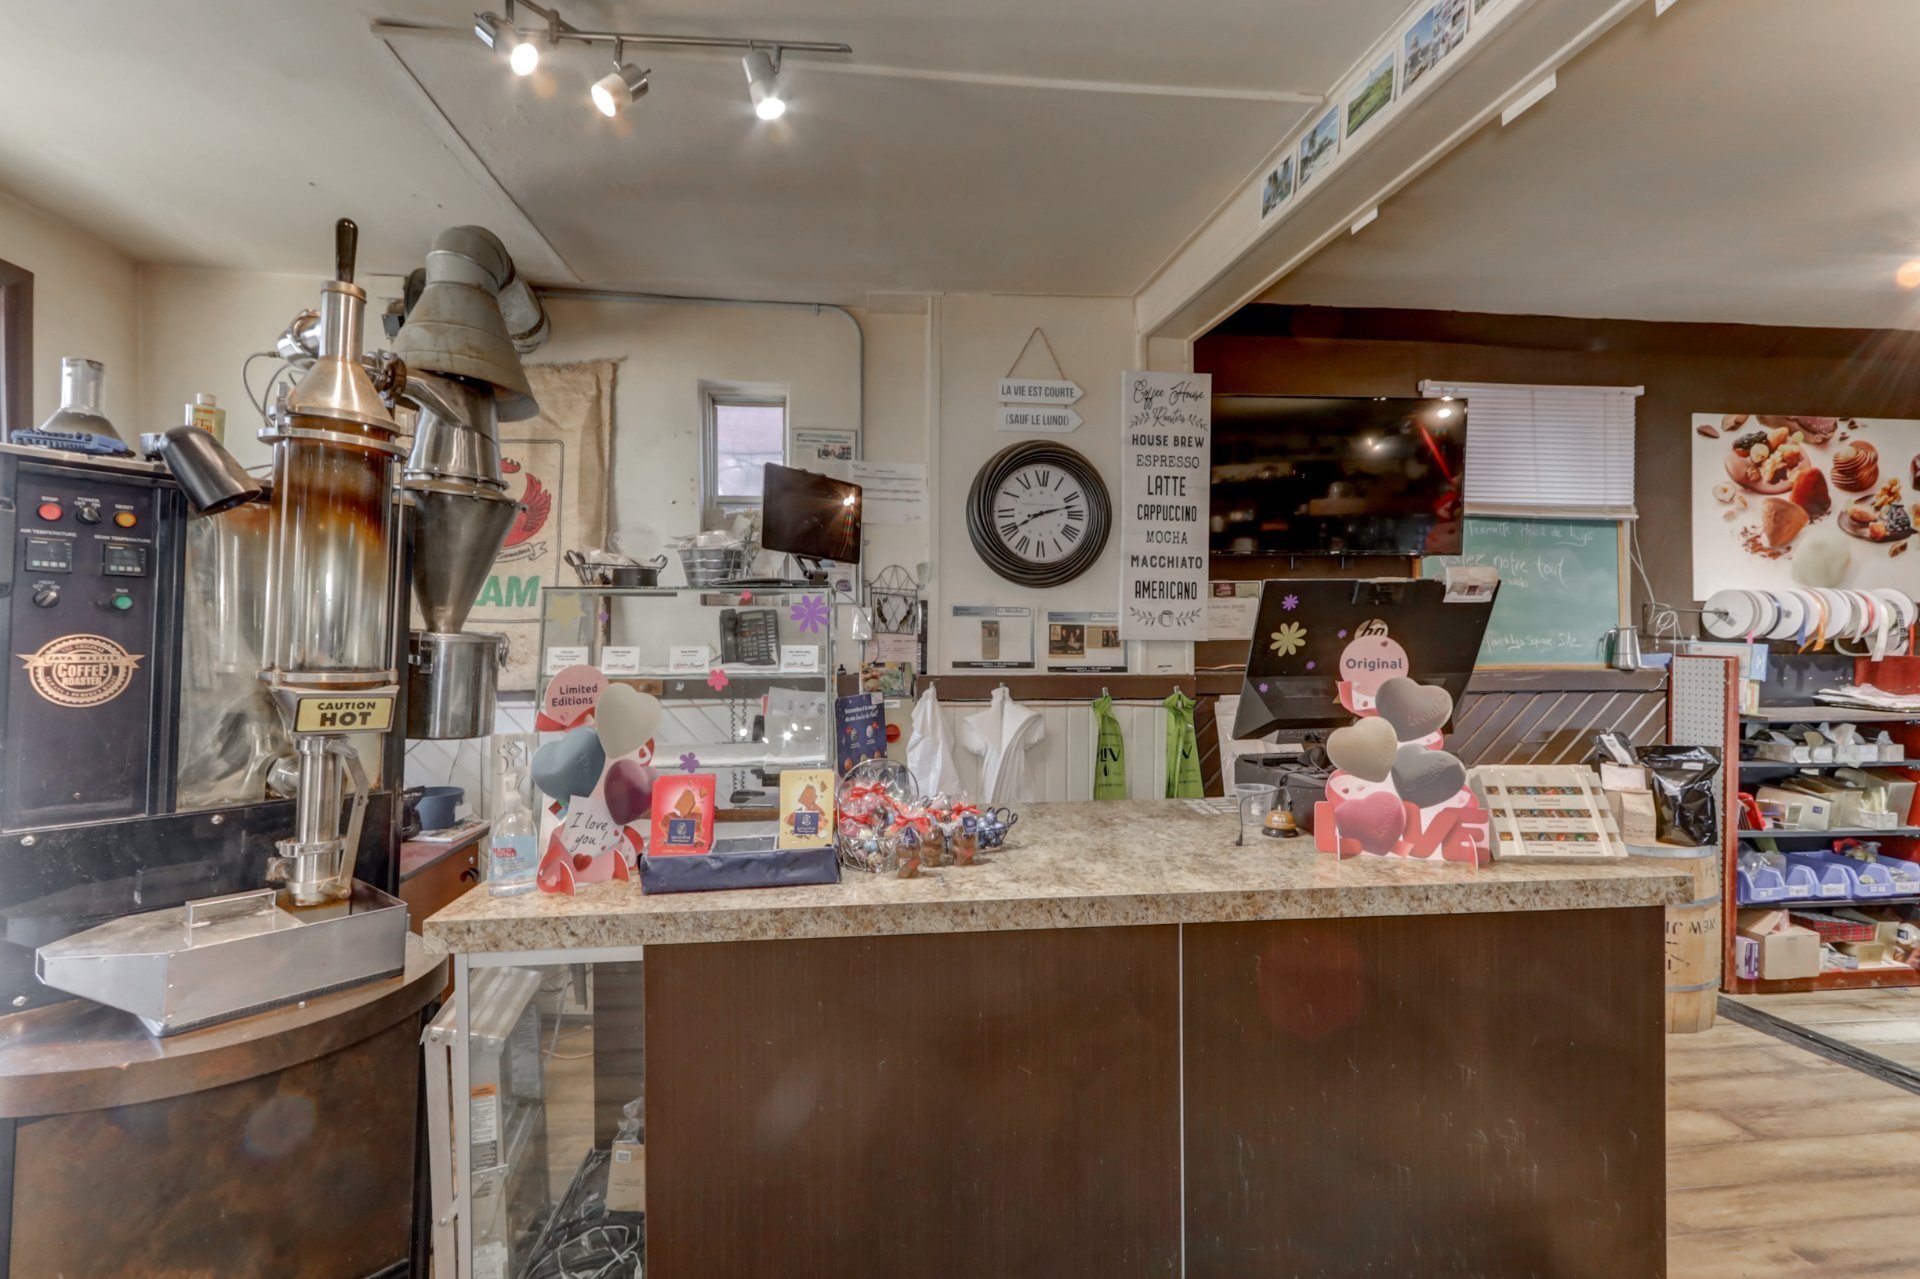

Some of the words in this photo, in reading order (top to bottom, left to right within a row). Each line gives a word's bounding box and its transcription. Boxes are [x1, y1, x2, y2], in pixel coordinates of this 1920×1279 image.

[1001, 384, 1012, 396] LA
[1013, 385, 1027, 396] VIE
[1028, 386, 1043, 397] EST
[1134, 379, 1166, 410] Coffee
[1169, 381, 1205, 405] House
[1005, 413, 1030, 426] (SAUF
[1031, 414, 1041, 425] LE
[1042, 415, 1070, 426] LUNDI)
[1132, 434, 1169, 447] HOUSE
[1173, 435, 1205, 448] BREW
[1136, 454, 1200, 469] ESPRESSO
[1147, 475, 1187, 497] LATTE
[1137, 503, 1197, 522] CAPPUCCINO
[32, 528, 78, 538] TEMPERATURE
[111, 535, 152, 544] TEMPERATURE
[1146, 530, 1188, 545] MOCHA
[1130, 554, 1203, 570] MACCHIATO
[1493, 552, 1529, 575] notre
[1134, 580, 1198, 601] AMERICANO
[57, 663, 107, 677] COFFEE
[1345, 657, 1403, 672] Original
[62, 676, 102, 686] ROASTER
[559, 683, 598, 696] Limited
[317, 702, 376, 711] CAUTION
[551, 696, 594, 708] Editions
[319, 711, 372, 727] HOT
[570, 812, 584, 829] I
[585, 814, 608, 831] love
[1314, 801, 1490, 865] LVE
[570, 832, 608, 853] you!
